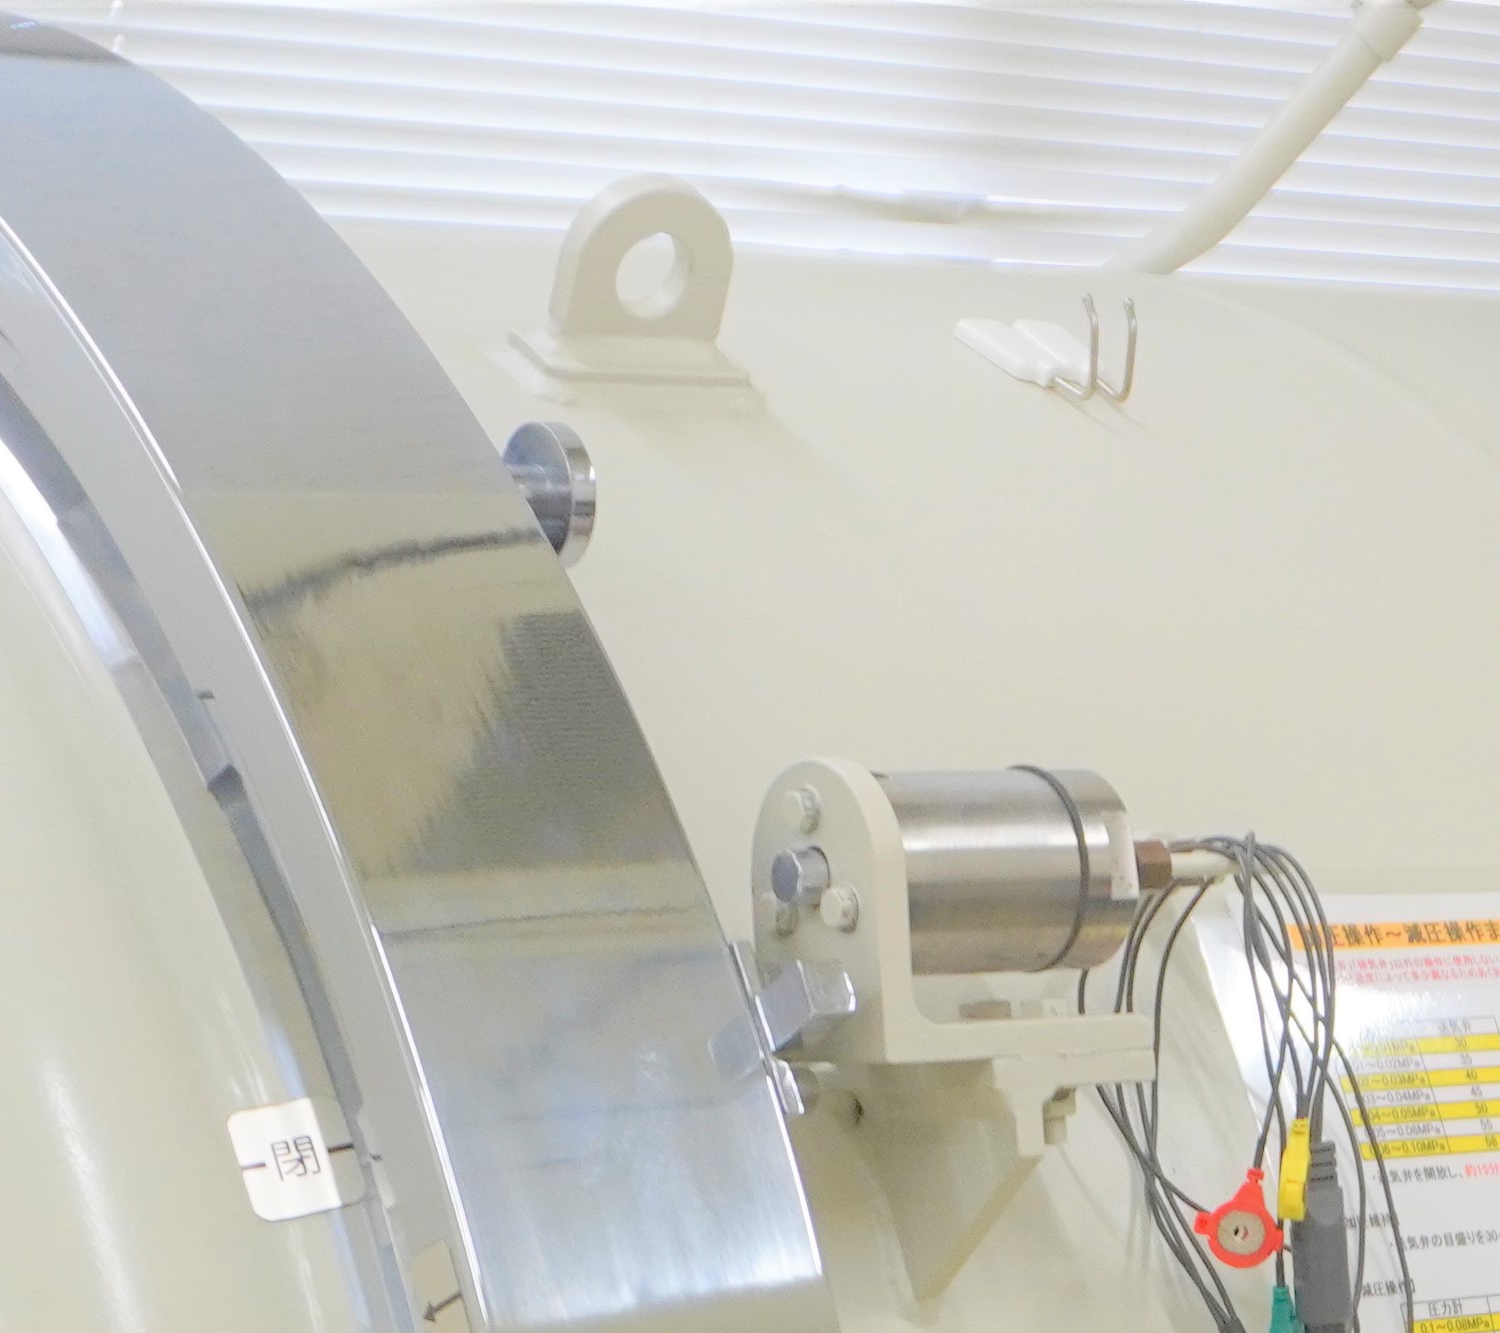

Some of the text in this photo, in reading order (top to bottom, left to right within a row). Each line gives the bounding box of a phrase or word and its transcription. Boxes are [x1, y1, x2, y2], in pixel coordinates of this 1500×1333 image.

[1466, 1069, 1478, 1080] 40
[1475, 1102, 1488, 1115] 50
[271, 1135, 320, 1183] 閉
[1429, 1297, 1464, 1315] 圧力計
